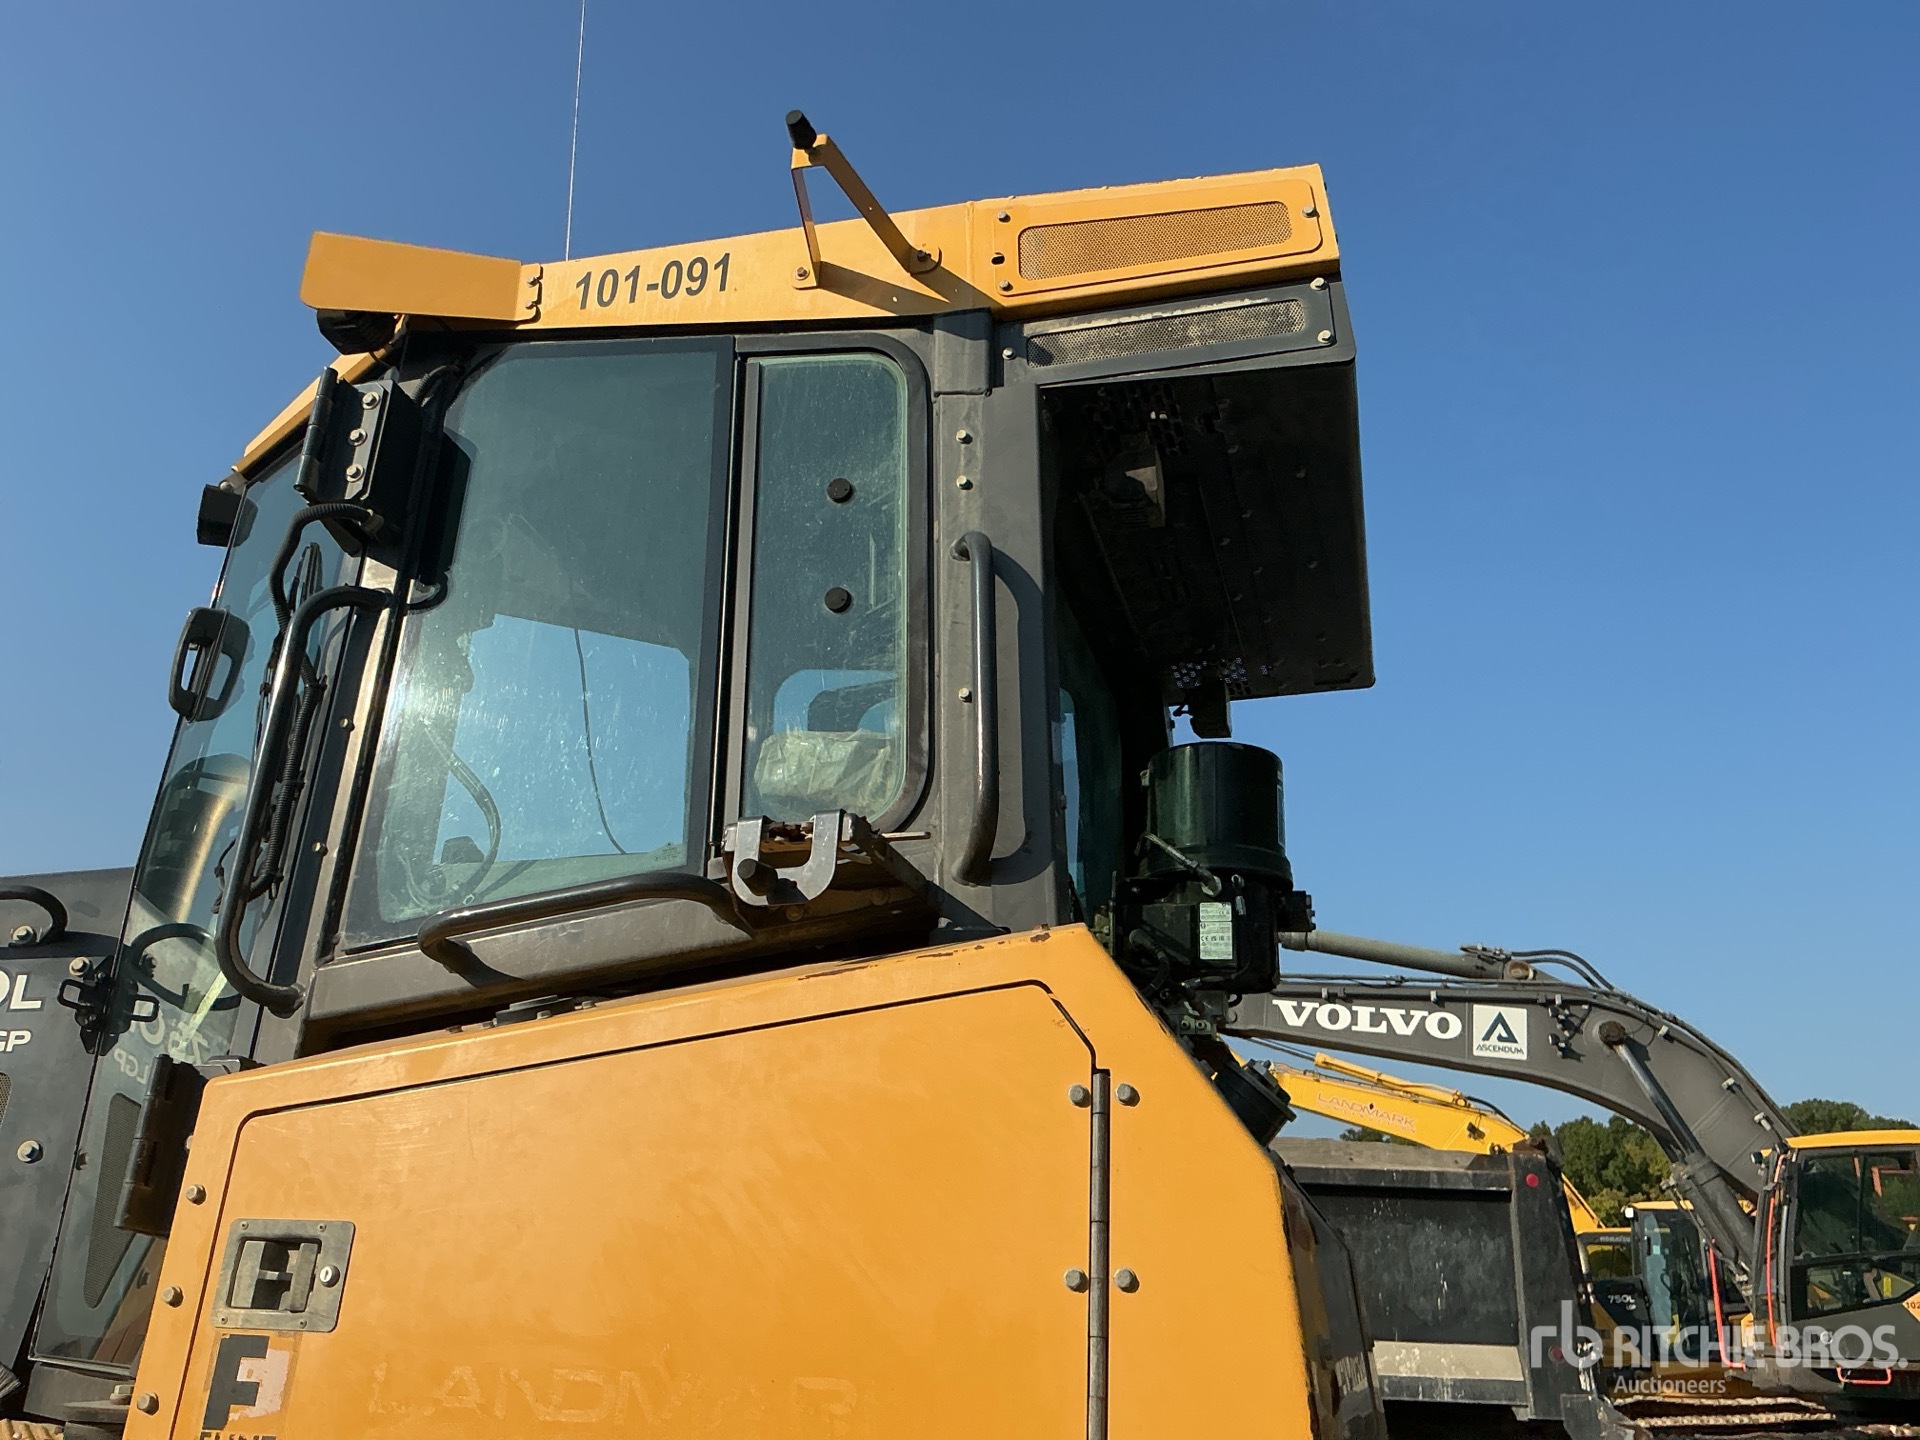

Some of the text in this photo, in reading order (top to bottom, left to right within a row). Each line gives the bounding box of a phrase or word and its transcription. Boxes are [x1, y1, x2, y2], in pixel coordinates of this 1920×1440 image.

[575, 253, 731, 310] 101-091
[1272, 999, 1462, 1040] VOLVO
[1476, 1044, 1524, 1055] ASCENDUM
[1317, 1093, 1415, 1129] LANDMARK
[1607, 1294, 1635, 1304] 750L
